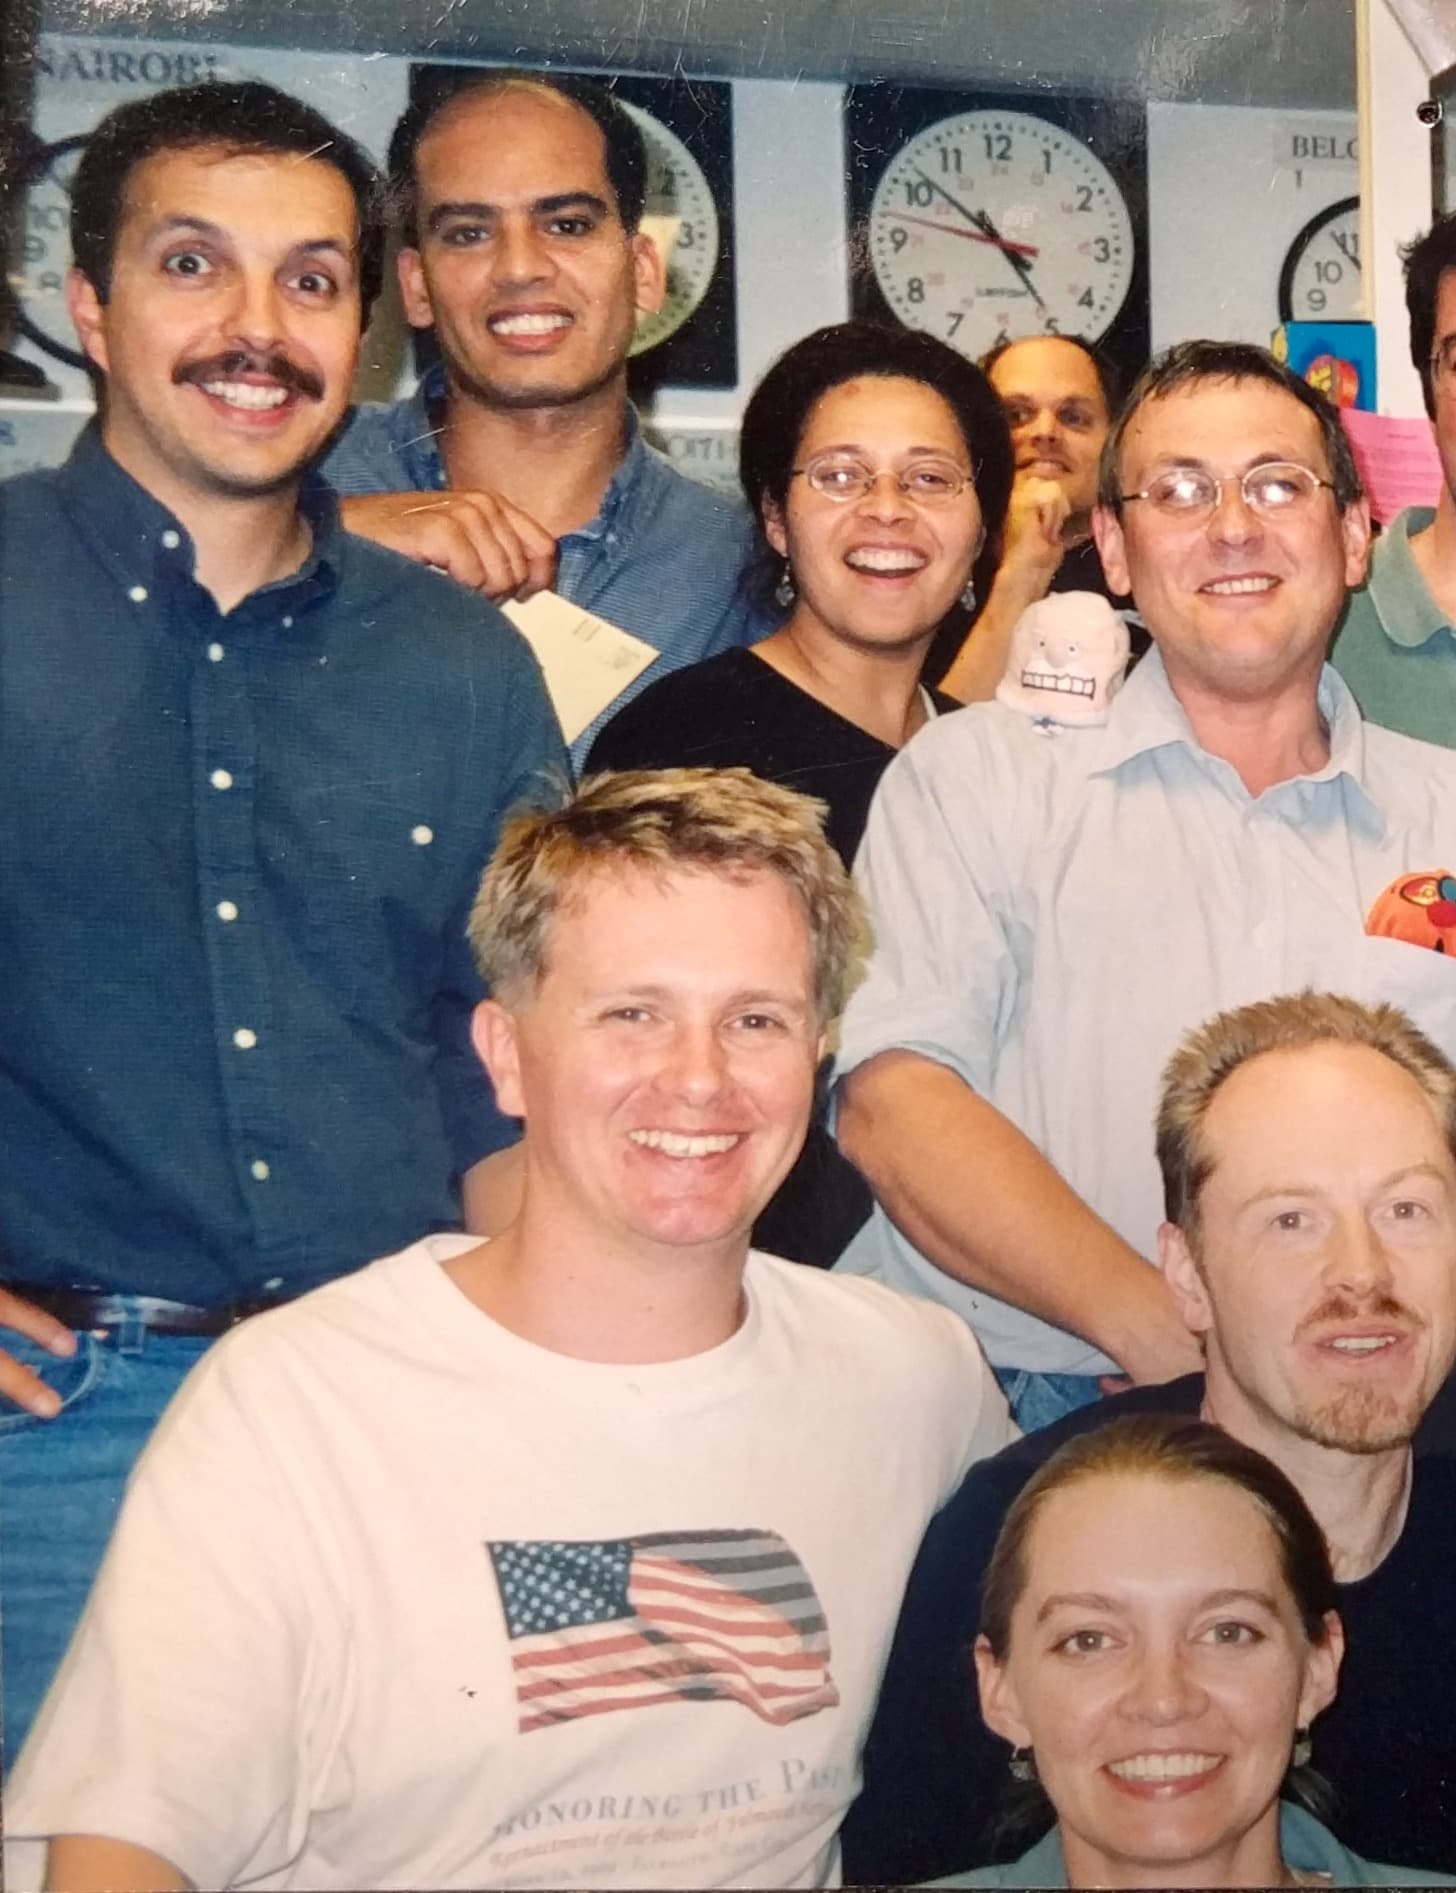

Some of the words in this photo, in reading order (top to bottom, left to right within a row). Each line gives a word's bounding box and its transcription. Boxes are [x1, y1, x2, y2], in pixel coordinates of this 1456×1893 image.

[984, 134, 1012, 160] 12
[939, 147, 962, 174] 11
[1042, 150, 1051, 174] 1
[905, 180, 933, 207] 10
[1076, 185, 1093, 212] 2
[676, 221, 695, 249] 3
[890, 228, 908, 254] 9
[1094, 238, 1110, 263] 3
[1315, 260, 1342, 284] 10
[907, 278, 925, 303] 8
[1077, 287, 1095, 309] 4
[1307, 289, 1326, 311] 9
[946, 313, 964, 337] 7
[696, 1778, 766, 1814] THE
